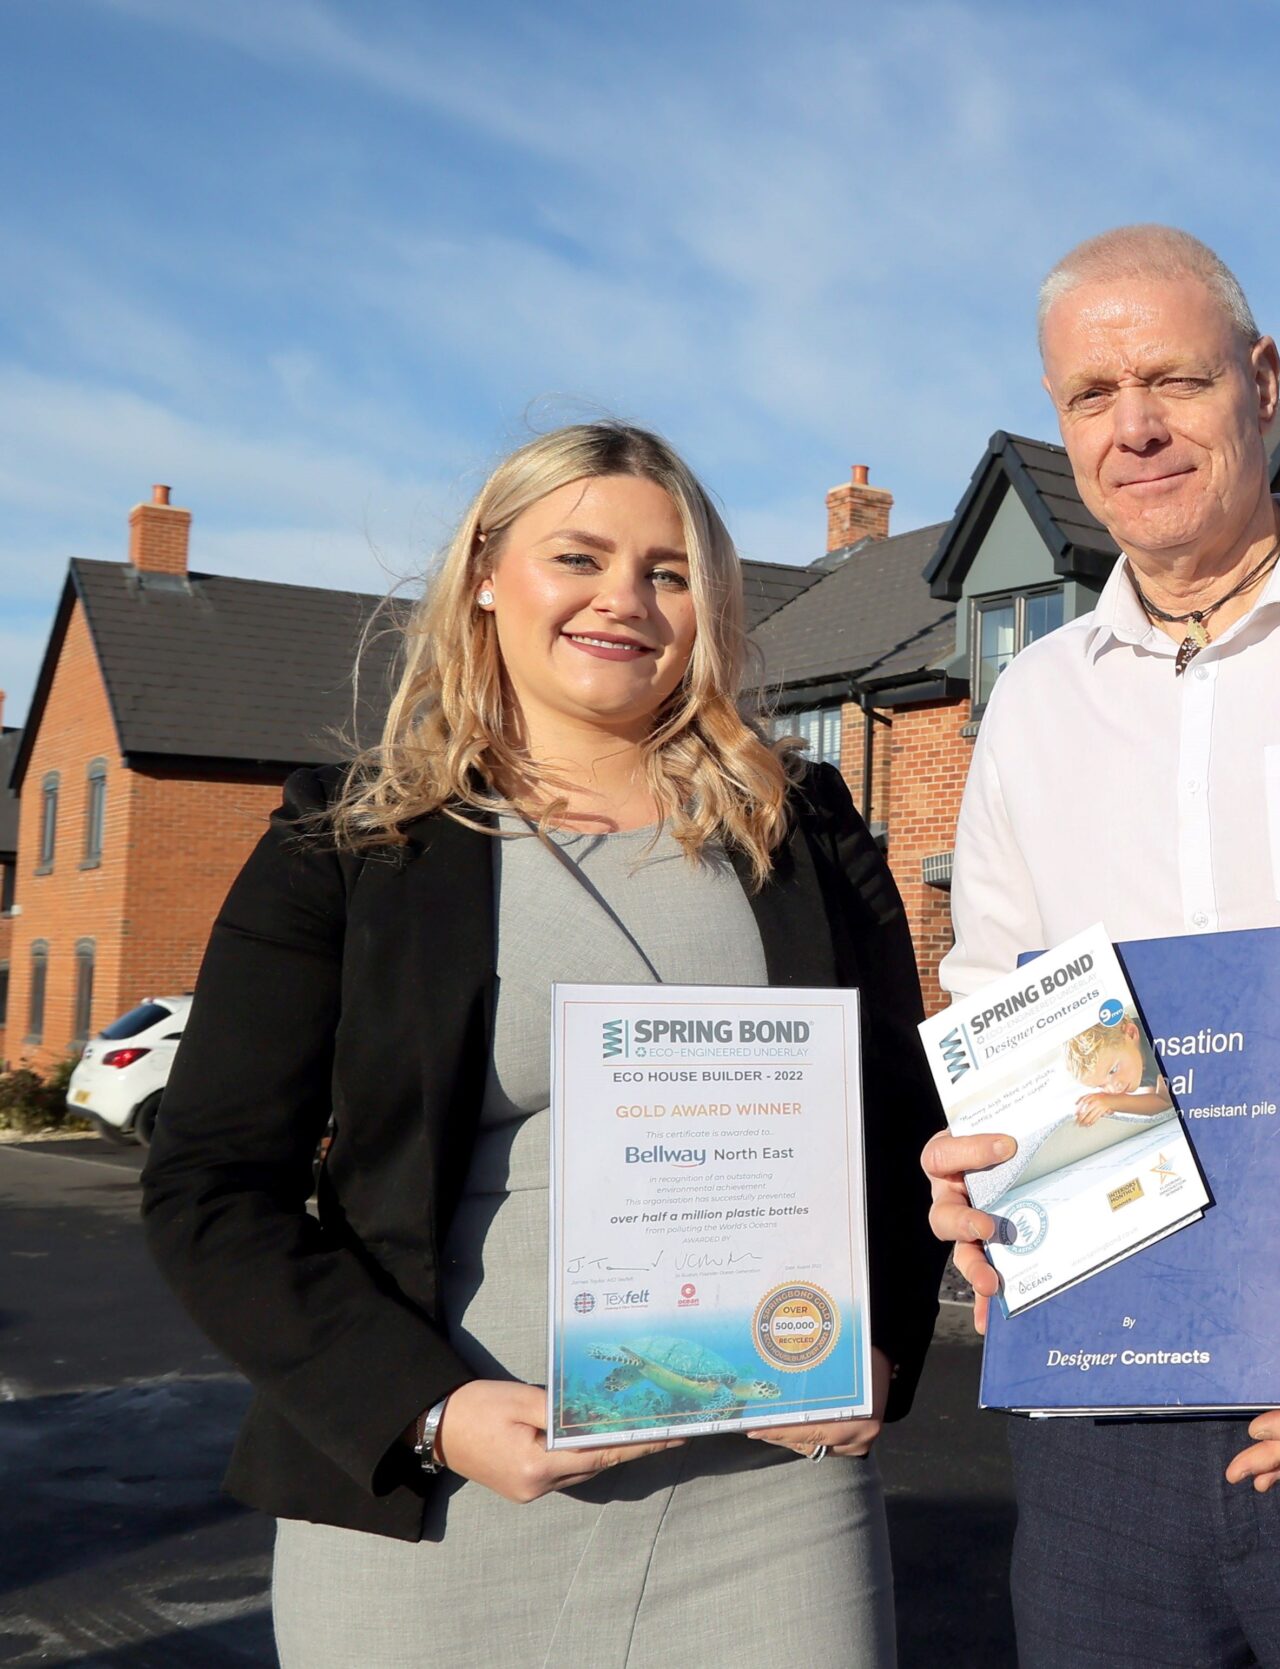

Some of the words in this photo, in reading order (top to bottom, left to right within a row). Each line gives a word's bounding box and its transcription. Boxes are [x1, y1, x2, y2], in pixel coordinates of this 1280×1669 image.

[970, 985, 1040, 1035] SPRING
[1040, 953, 1095, 996] BOND
[634, 1019, 732, 1043] SPRING
[739, 1020, 810, 1043] BOND
[985, 1024, 1035, 1059] Designer
[1036, 989, 1100, 1029] Contracts
[649, 1047, 751, 1057] ECO-ENGINEERED
[754, 1047, 809, 1057] UNDERLAY
[613, 1072, 643, 1082] ECO
[648, 1071, 698, 1082] HOUSE
[702, 1071, 762, 1081] BUILDER
[774, 1071, 803, 1081] 2022
[615, 1105, 666, 1118] GOLD
[671, 1104, 731, 1117] AWARD
[736, 1102, 802, 1115] WINNER
[1189, 1103, 1248, 1118] resistant
[1251, 1101, 1276, 1118] pile
[646, 1131, 664, 1139] This
[665, 1129, 710, 1139] certificate
[720, 1128, 757, 1137] awarded
[625, 1145, 706, 1166] Bellway
[714, 1148, 757, 1160] North
[763, 1147, 794, 1159] East
[658, 1174, 704, 1185] recognition
[705, 1173, 714, 1182] of
[726, 1171, 773, 1181] outstanding
[656, 1185, 715, 1194] environmental
[625, 1198, 641, 1206] This
[643, 1197, 694, 1207] organisation
[695, 1195, 709, 1203] has
[711, 1193, 756, 1203] successfully
[757, 1191, 796, 1201] prevented
[610, 1214, 639, 1224] over
[641, 1211, 669, 1223] half
[670, 1213, 678, 1221] a
[681, 1209, 722, 1220] million
[725, 1207, 765, 1220] plastic
[769, 1205, 809, 1216] bottles
[646, 1226, 665, 1235] from
[666, 1224, 703, 1235] polluting
[704, 1223, 717, 1232] the
[719, 1222, 747, 1231] World's
[748, 1221, 777, 1229] Oceans
[682, 1235, 720, 1244] AWARDED
[602, 1289, 649, 1306] Texfelt
[762, 1289, 814, 1320] SPRINGBOND
[814, 1297, 831, 1320] GOLD
[783, 1306, 808, 1314] OVER
[775, 1321, 815, 1330] 500,000
[1122, 1316, 1136, 1329] By
[1047, 1350, 1117, 1371] Designer
[1121, 1349, 1211, 1365] Contracts
